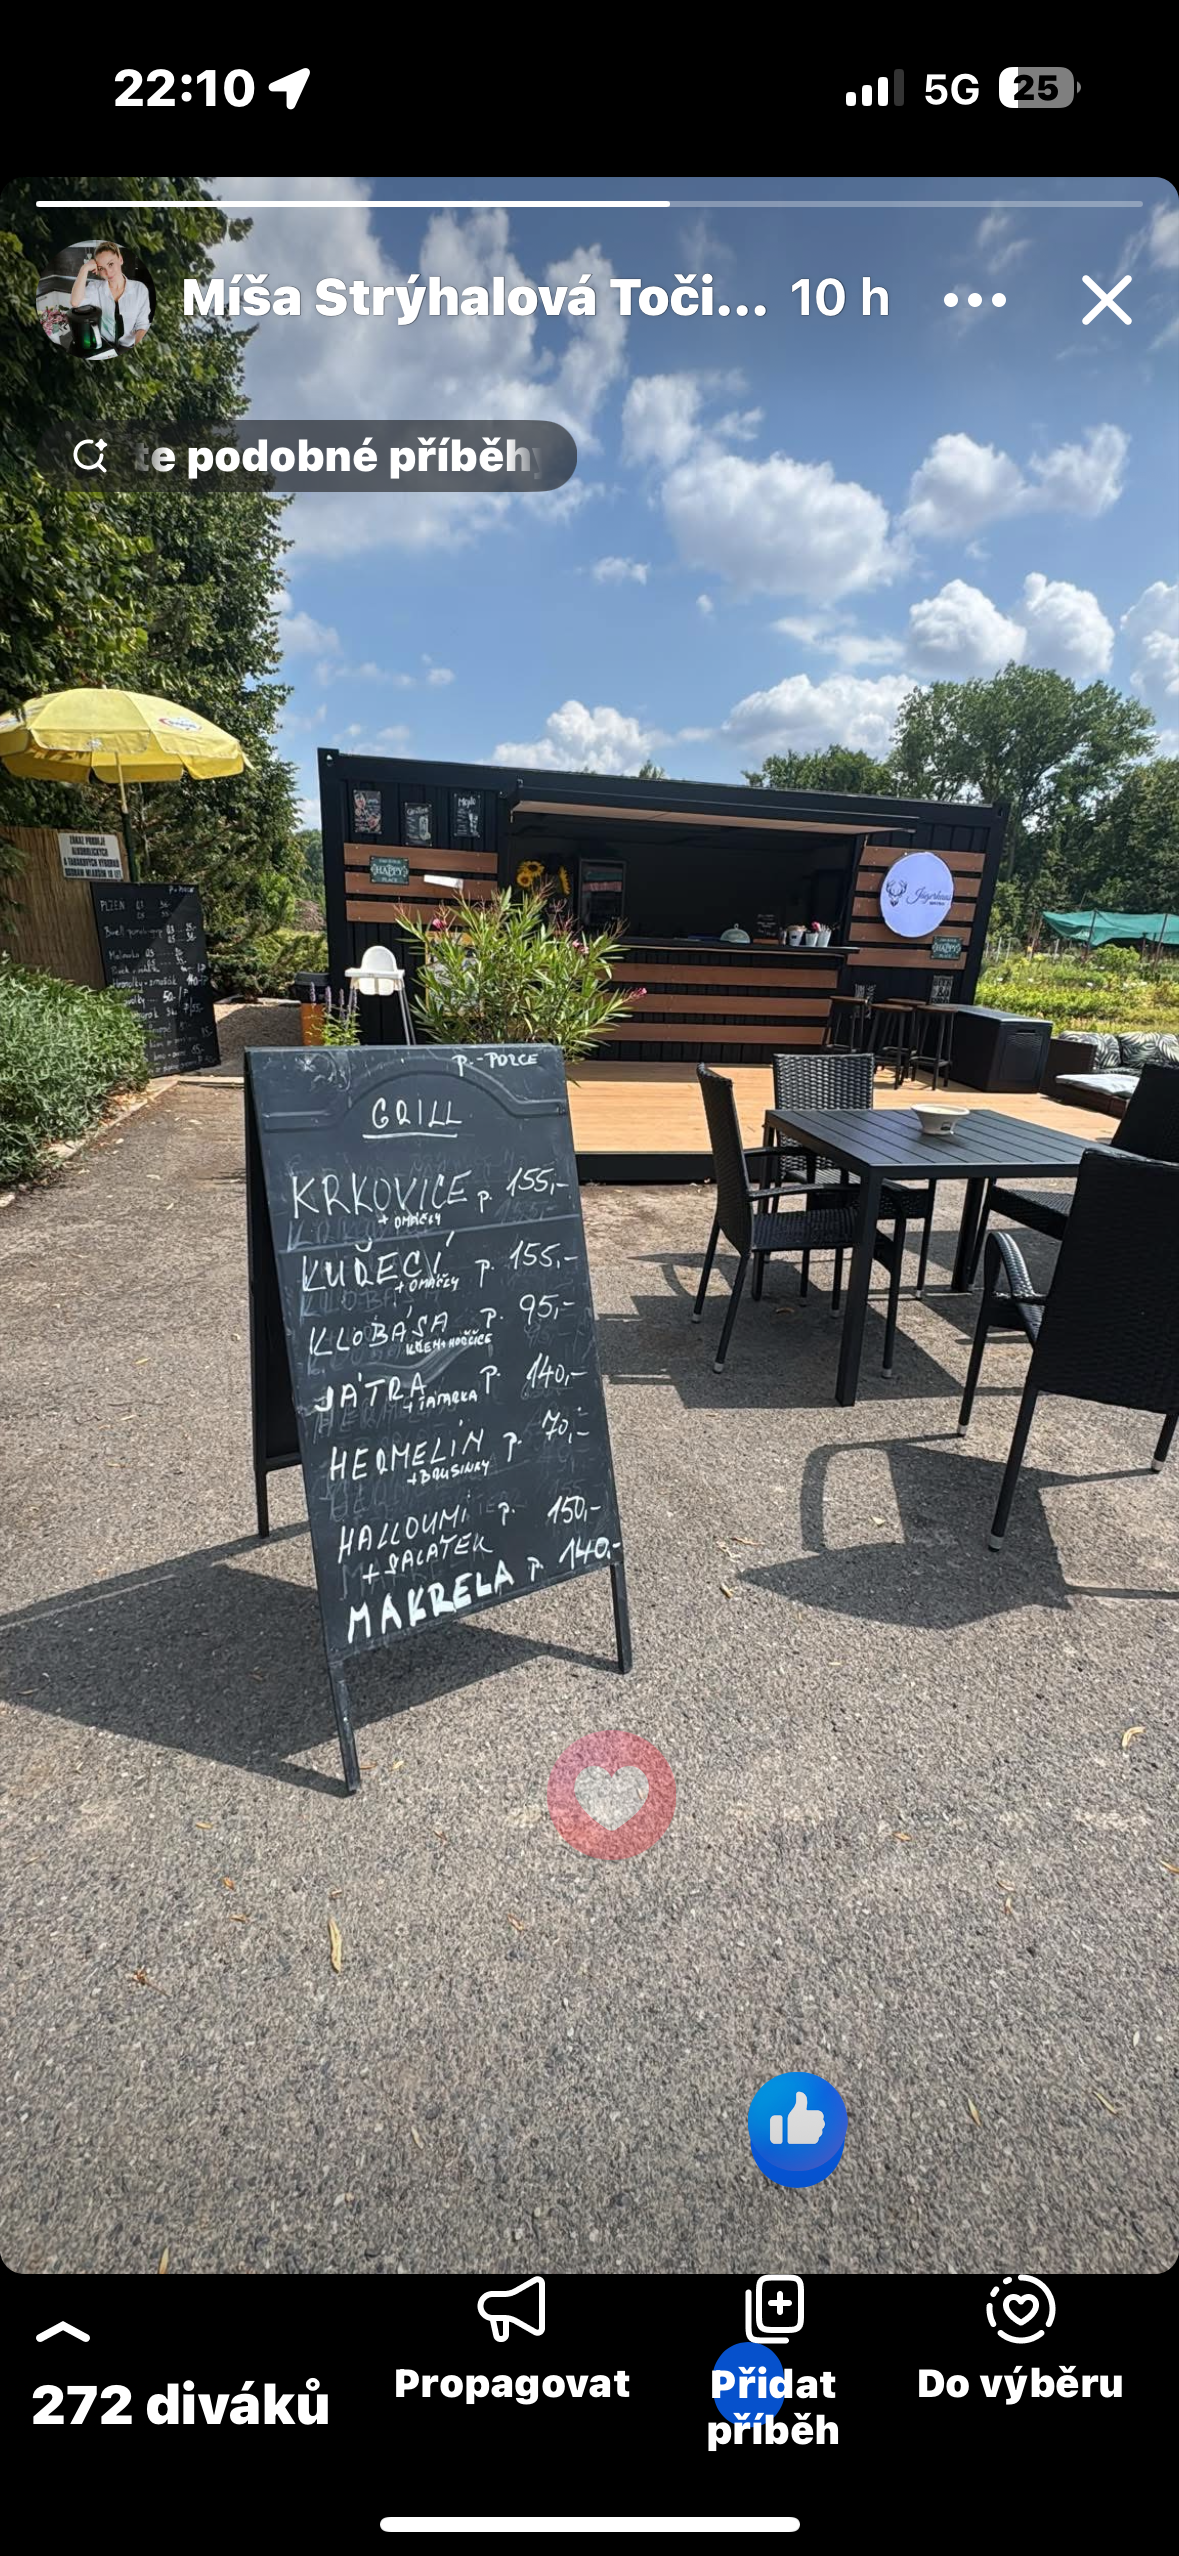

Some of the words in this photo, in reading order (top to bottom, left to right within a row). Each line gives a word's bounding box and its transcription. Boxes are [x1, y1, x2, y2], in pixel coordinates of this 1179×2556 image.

[371, 1097, 463, 1130] GRILL
[292, 1169, 473, 1220] KRKOVICE
[302, 1230, 455, 1292] KUŘECÍ
[309, 1305, 449, 1358] KLOBÁSA
[314, 1372, 428, 1413] JÁTRA
[337, 1501, 468, 1564] HALLOUMI
[347, 1559, 516, 1644] MAKRELA
